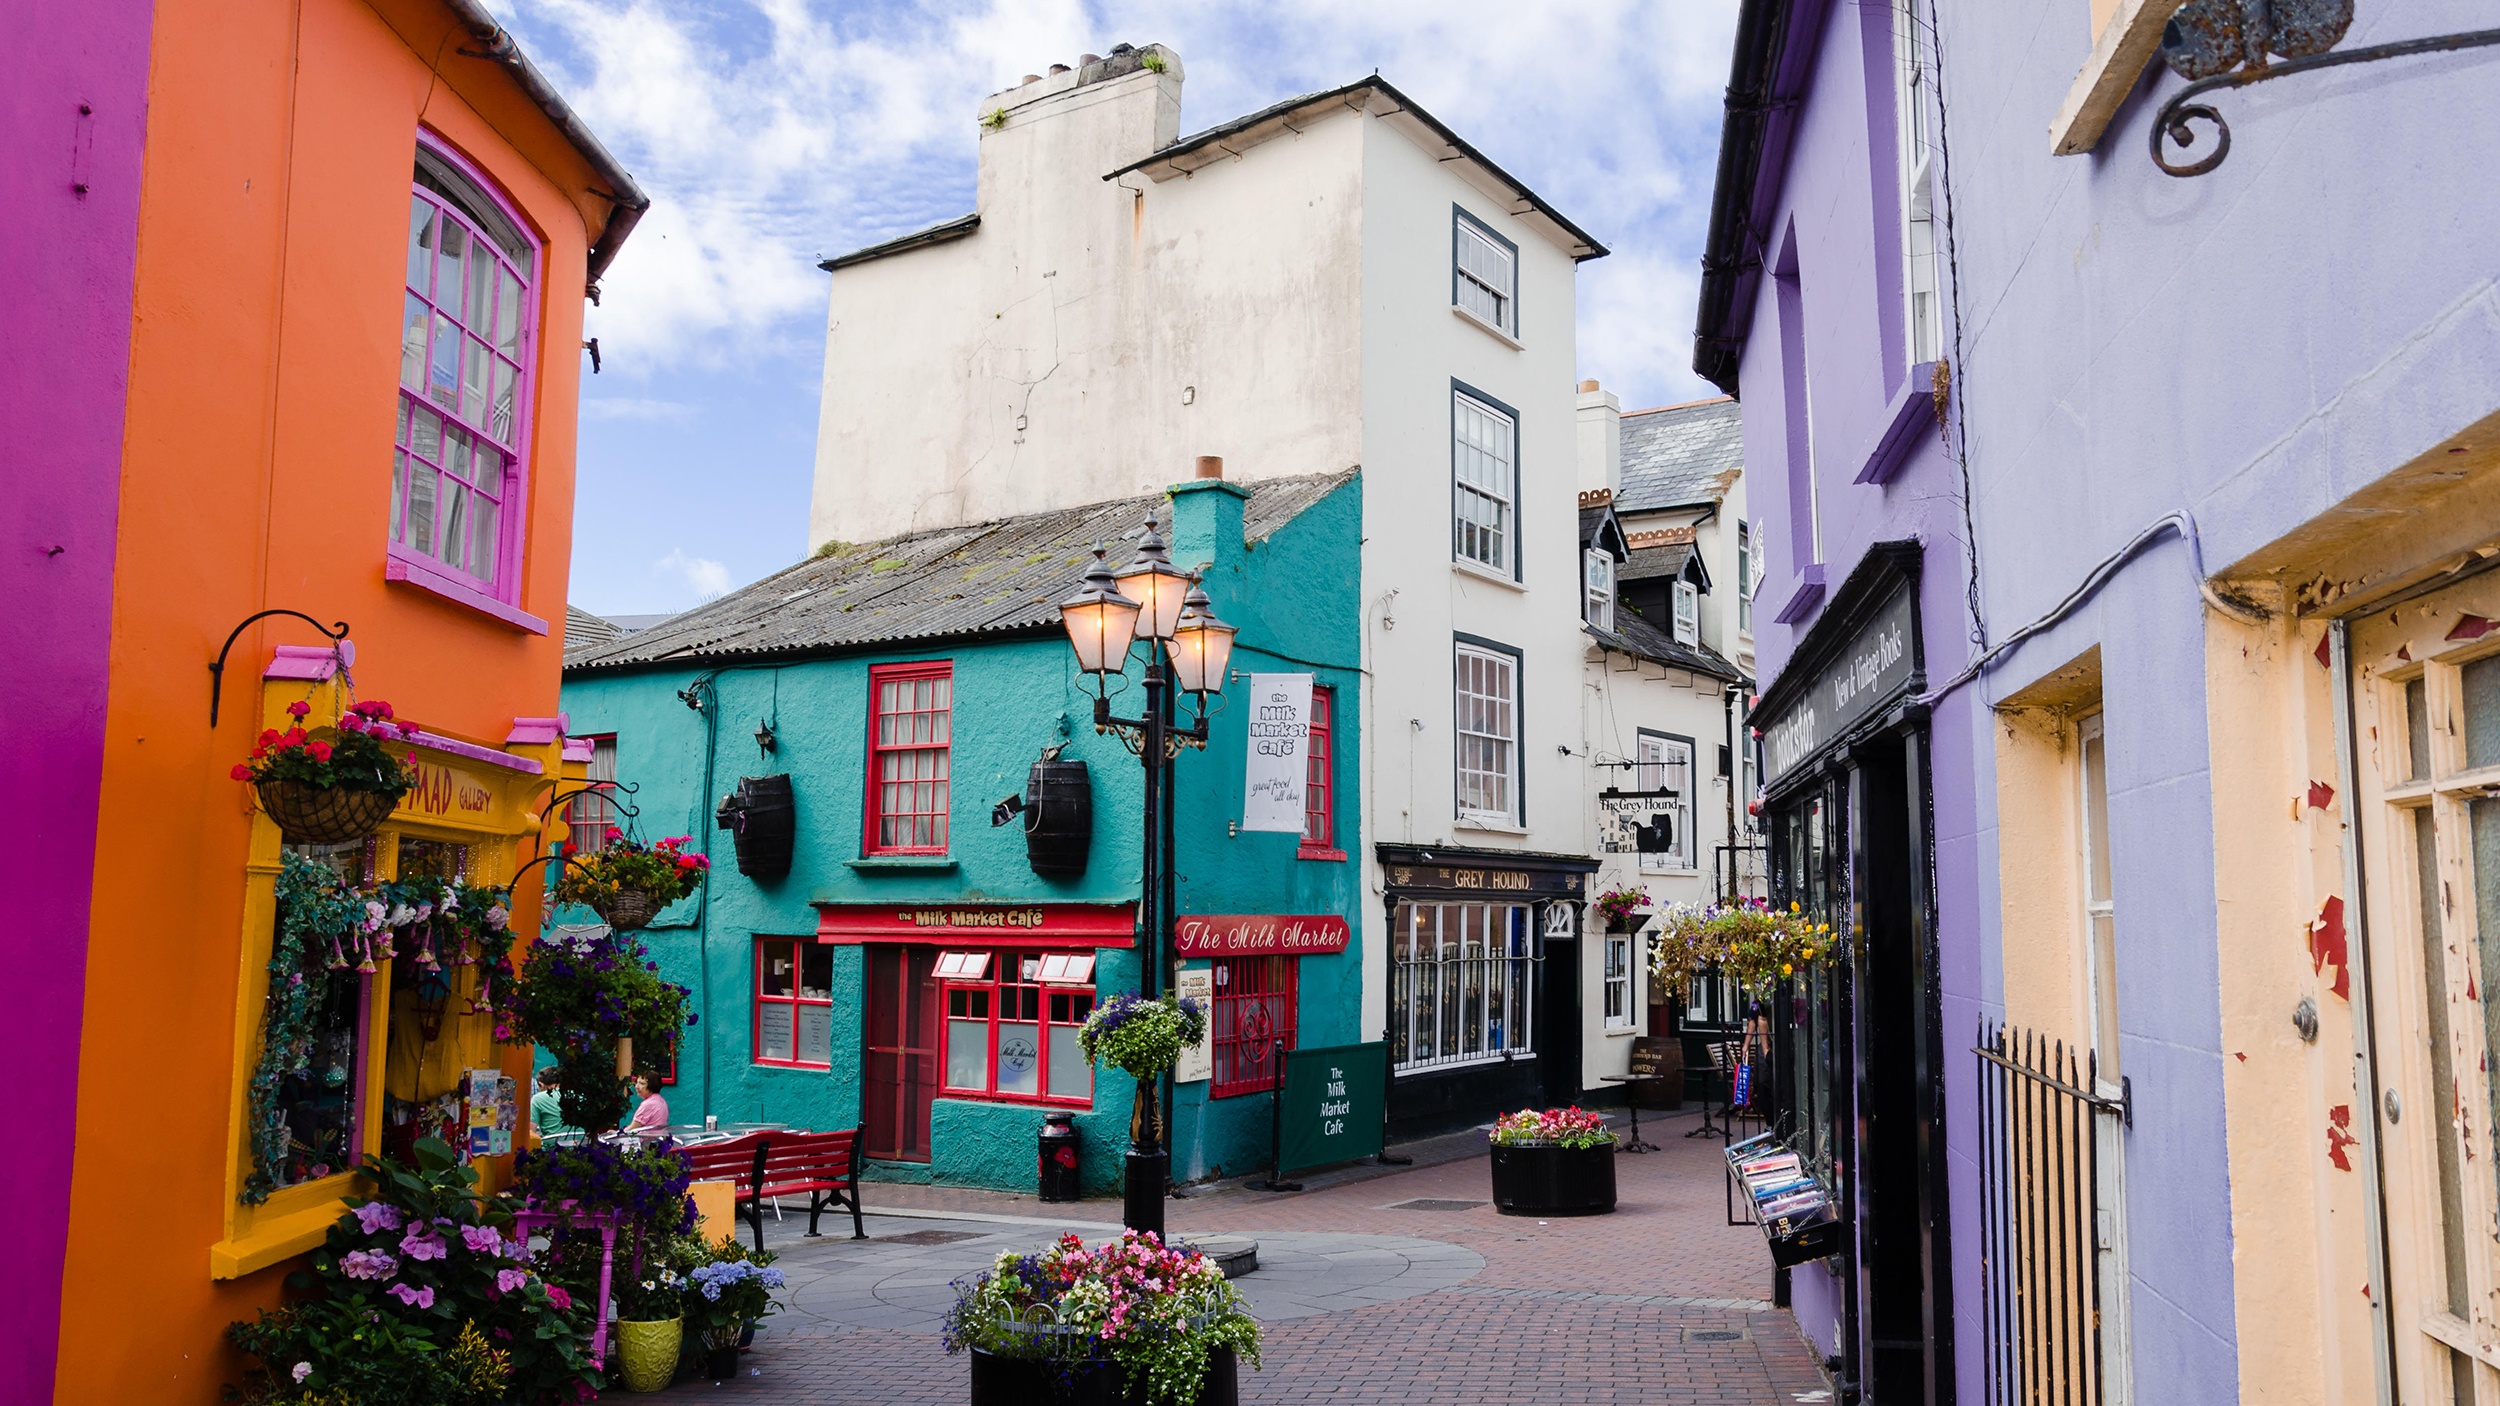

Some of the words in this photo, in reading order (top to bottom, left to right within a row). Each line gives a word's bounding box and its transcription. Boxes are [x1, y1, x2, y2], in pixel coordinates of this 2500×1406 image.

[1834, 676, 1850, 712] New
[1855, 653, 1880, 692] Vintage
[1879, 621, 1902, 672] Books
[1271, 693, 1288, 703] the
[1260, 705, 1296, 722] Milk
[1250, 722, 1307, 738] Market
[1257, 739, 1294, 757] Café
[1250, 779, 1273, 797] great
[1270, 776, 1291, 795] food
[459, 785, 492, 814] GALLERY
[1274, 789, 1285, 802] all
[1286, 789, 1299, 806] day
[1599, 798, 1620, 813] The
[1620, 798, 1643, 813] Grey
[1644, 798, 1677, 810] Hound
[1439, 868, 1450, 878] THE
[1455, 869, 1485, 888] GREY
[1492, 872, 1529, 889] HOUND
[898, 911, 913, 921] the
[915, 910, 948, 927] Milk
[950, 910, 1006, 927] Market
[1006, 908, 1043, 929] Café
[1180, 921, 1221, 950] The
[1228, 922, 1275, 949] Milk
[1281, 921, 1343, 948] Market
[1330, 1067, 1343, 1079] The
[1327, 1081, 1346, 1097] Milk
[1320, 1100, 1350, 1117] Market
[1324, 1119, 1344, 1136] Cafe
